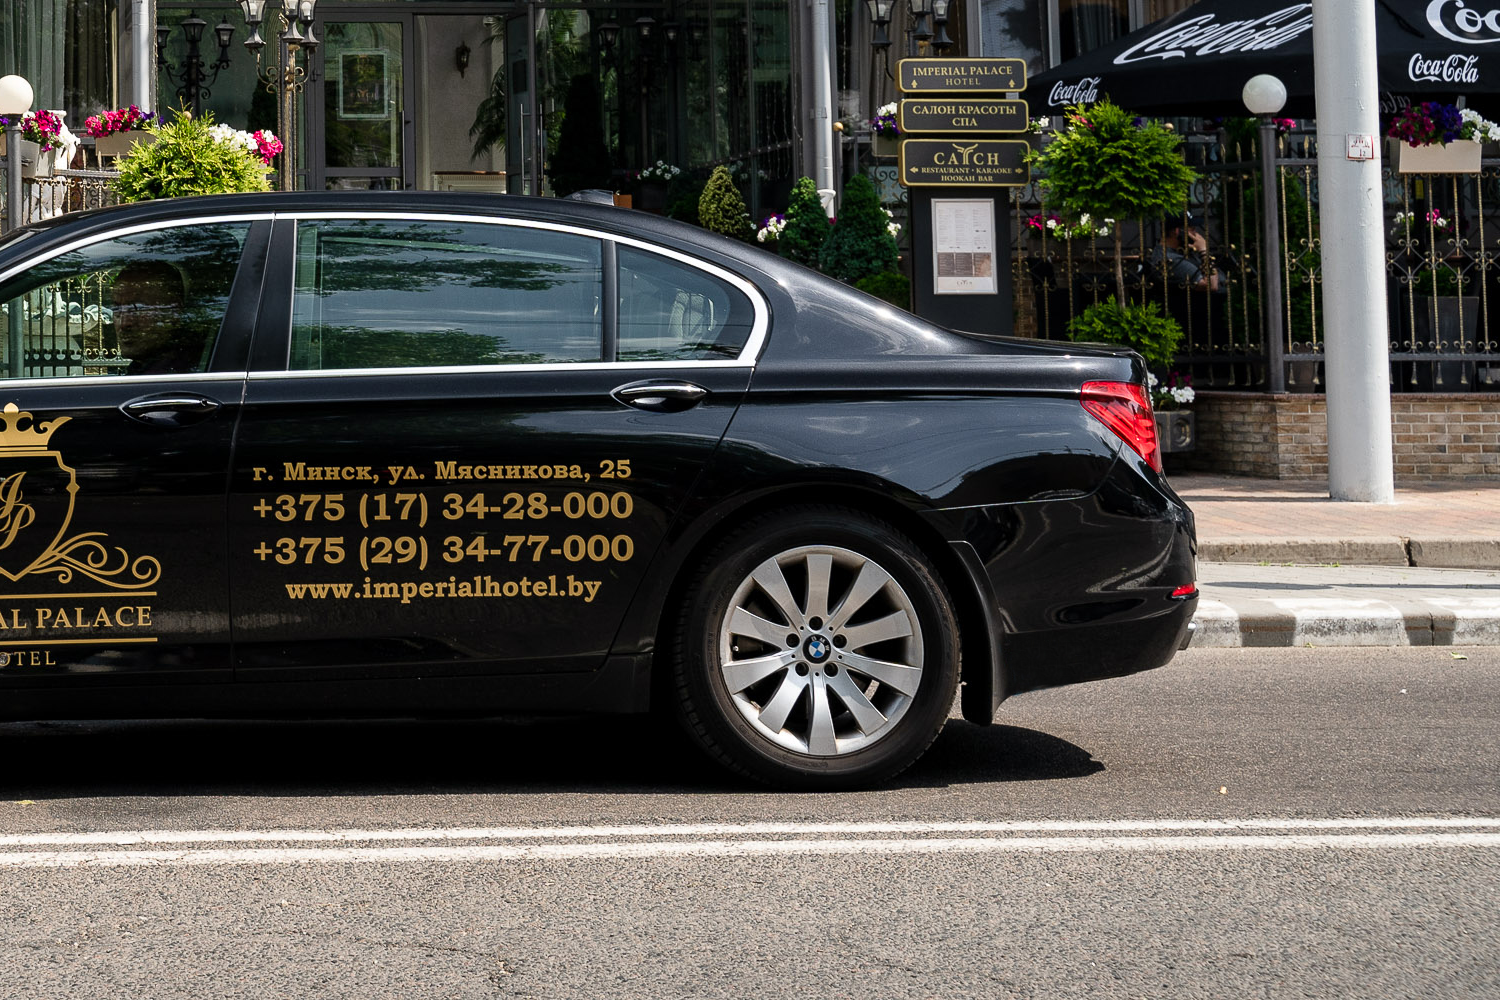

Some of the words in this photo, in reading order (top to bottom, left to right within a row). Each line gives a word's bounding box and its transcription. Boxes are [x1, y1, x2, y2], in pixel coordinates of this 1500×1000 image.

[912, 66, 968, 77] IMPERIAL
[969, 65, 1013, 76] PALACE
[1408, 52, 1479, 84] Coca-Cola
[945, 78, 981, 86] HOTEL
[912, 105, 956, 115] САЛОН
[958, 105, 1017, 115] КРАСОТЫ
[952, 117, 978, 127] СПА
[933, 143, 1000, 166] CATCH
[252, 467, 274, 482] г.
[283, 462, 380, 485] Минск,
[387, 466, 426, 486] ул.
[434, 460, 591, 484] Мясникова,
[598, 459, 632, 479] 25
[252, 493, 346, 522] +375
[359, 492, 429, 529] (17)
[441, 491, 634, 521] 34-28-000
[252, 536, 346, 565] +375
[358, 535, 429, 572] (29)
[441, 534, 635, 563] 34-77-000
[285, 574, 603, 604] www.imperialhotel.by
[35, 605, 153, 629] PALACE
